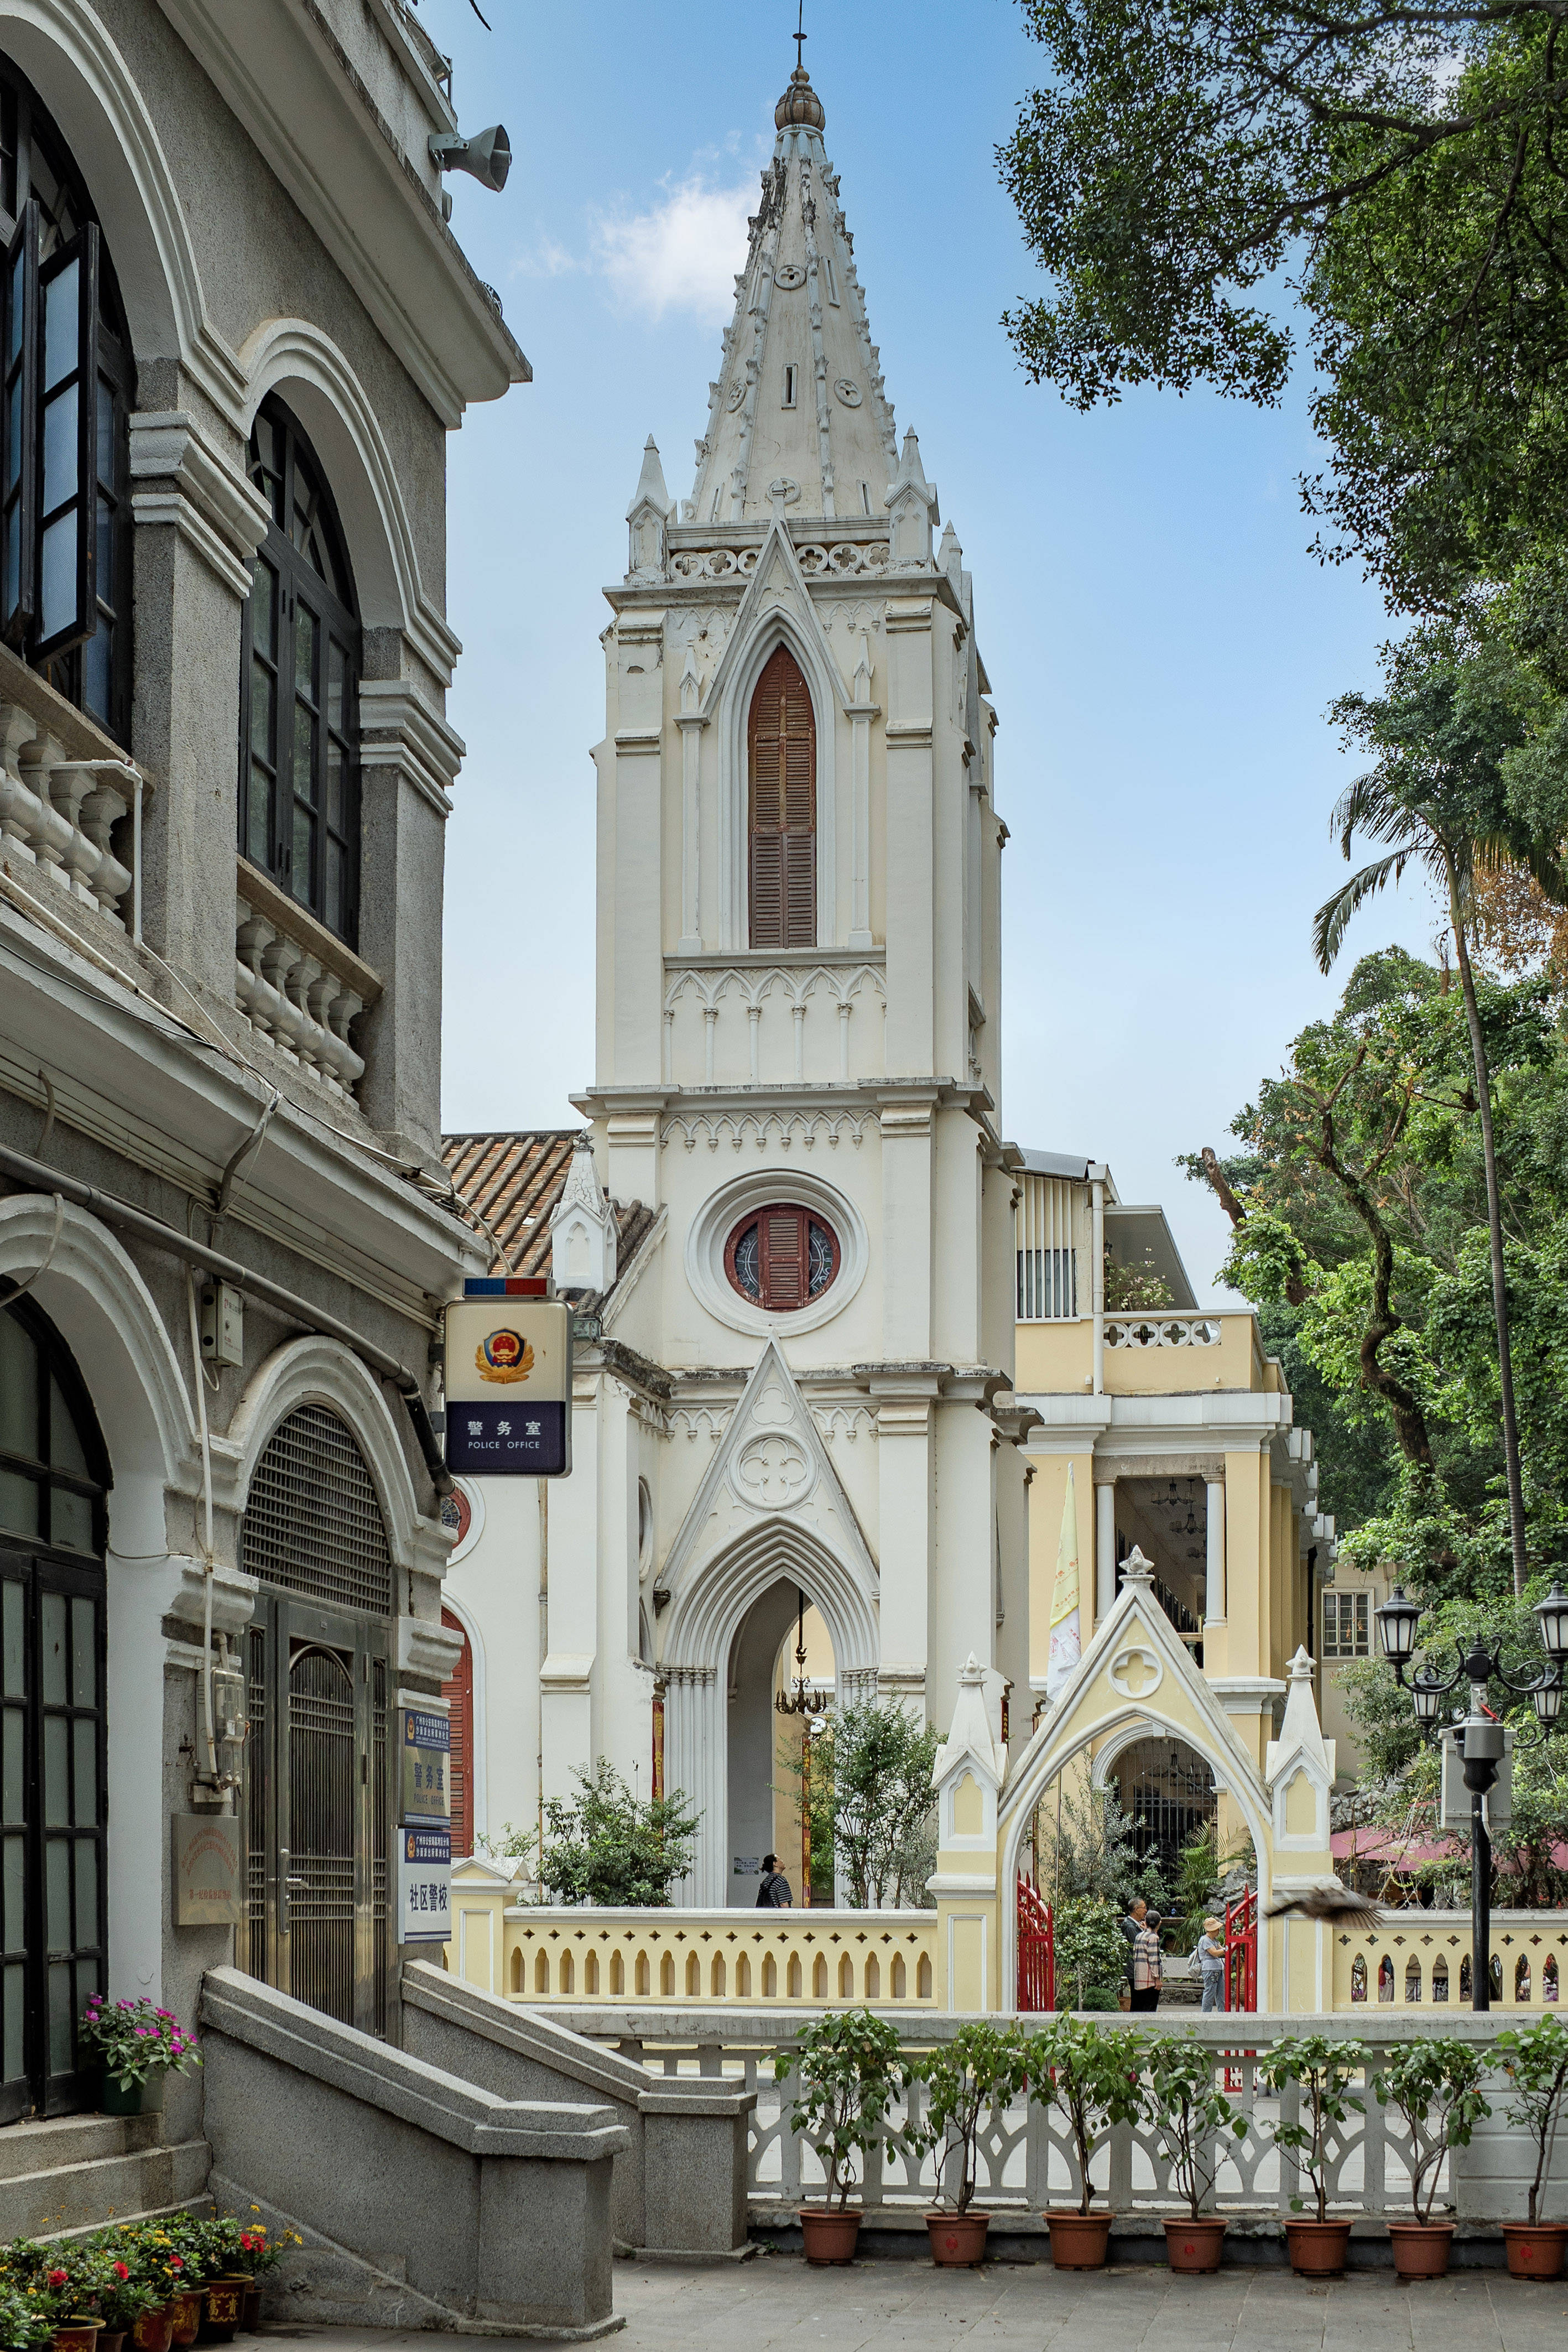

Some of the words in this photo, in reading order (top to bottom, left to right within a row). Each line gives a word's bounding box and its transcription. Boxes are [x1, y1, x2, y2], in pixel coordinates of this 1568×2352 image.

[467, 1420, 541, 1435] 警务室
[468, 1441, 500, 1449] POLICE
[507, 1441, 540, 1449] OFFICE
[414, 1762, 444, 1791] 警务室
[414, 1793, 428, 1804] POLICE
[430, 1796, 444, 1806] OFFICE
[410, 1883, 447, 1912] 社区警校
